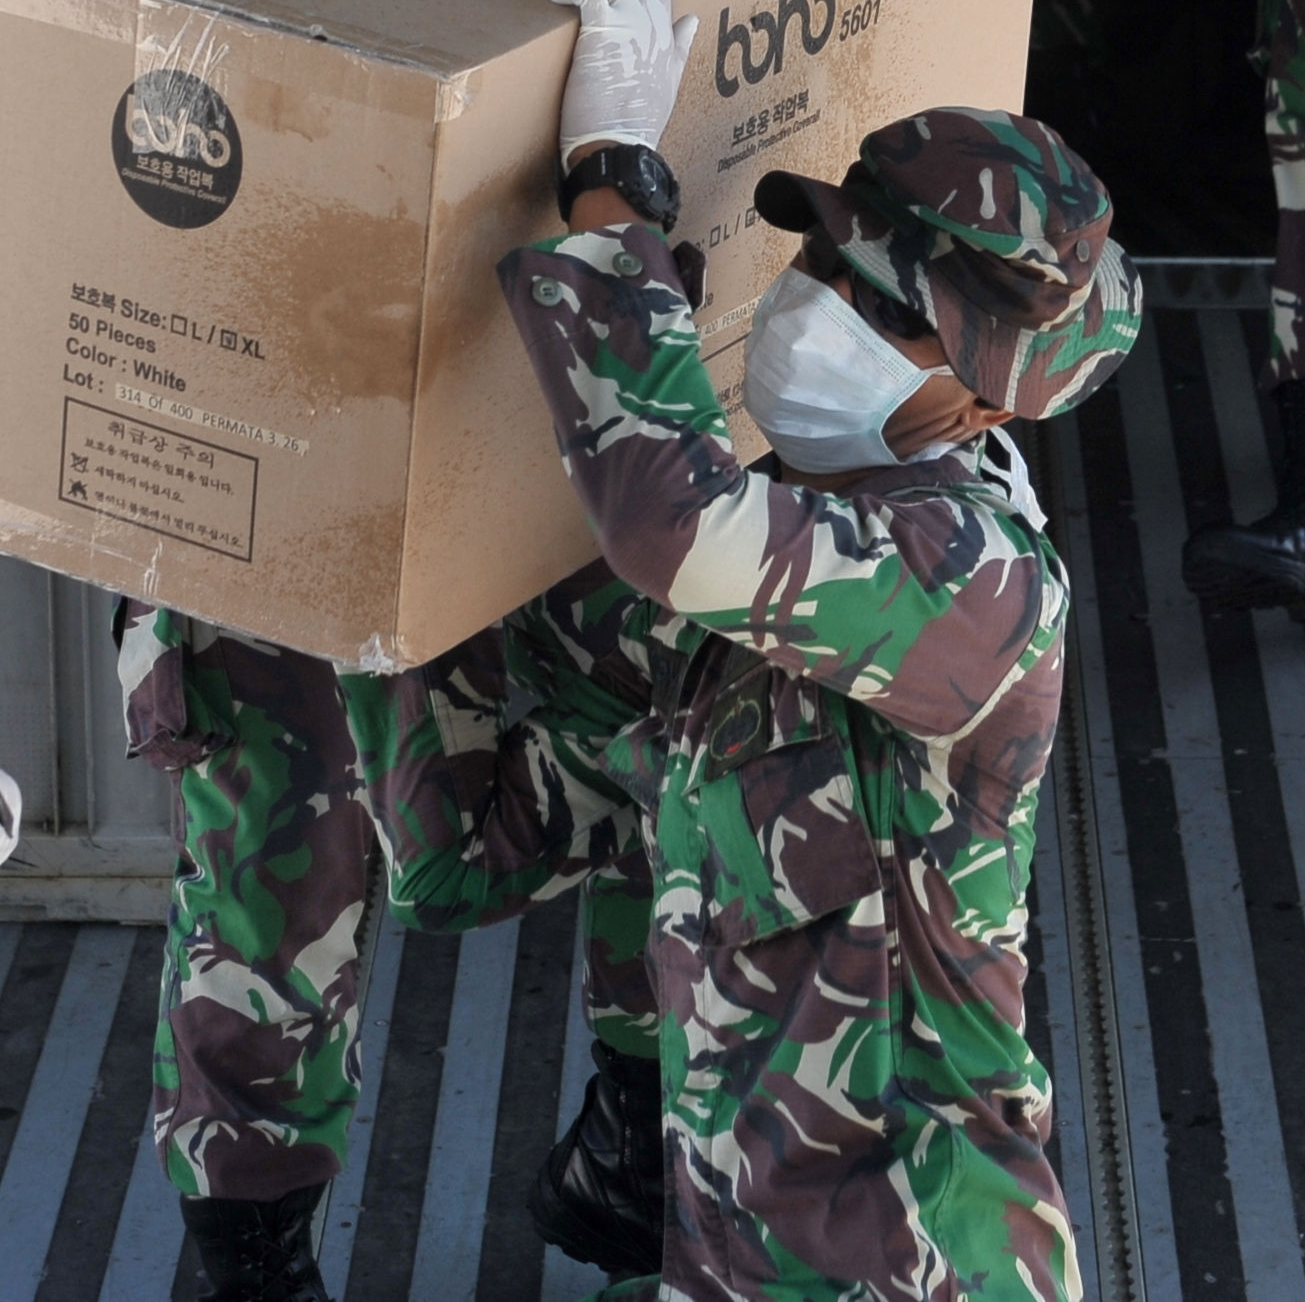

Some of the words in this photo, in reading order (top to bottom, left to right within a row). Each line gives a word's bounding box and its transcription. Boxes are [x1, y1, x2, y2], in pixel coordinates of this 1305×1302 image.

[731, 109, 770, 147] 보호용
[772, 88, 809, 124] 작업복
[136, 154, 174, 179] 보호용
[176, 165, 214, 190] 작업복
[68, 312, 90, 334] 50
[96, 320, 156, 354] Pieces
[70, 282, 117, 314] 보호복
[120, 298, 167, 330] Size:
[192, 321, 203, 341] L
[241, 337, 265, 360] XL
[63, 363, 94, 391] Lot
[66, 337, 117, 368] Color
[133, 359, 186, 392] White
[119, 386, 141, 403] 314
[148, 395, 163, 410] Of
[170, 402, 193, 420] 400
[202, 412, 264, 442] PERMATA
[107, 418, 168, 455] 취급상
[174, 440, 215, 470] 주의
